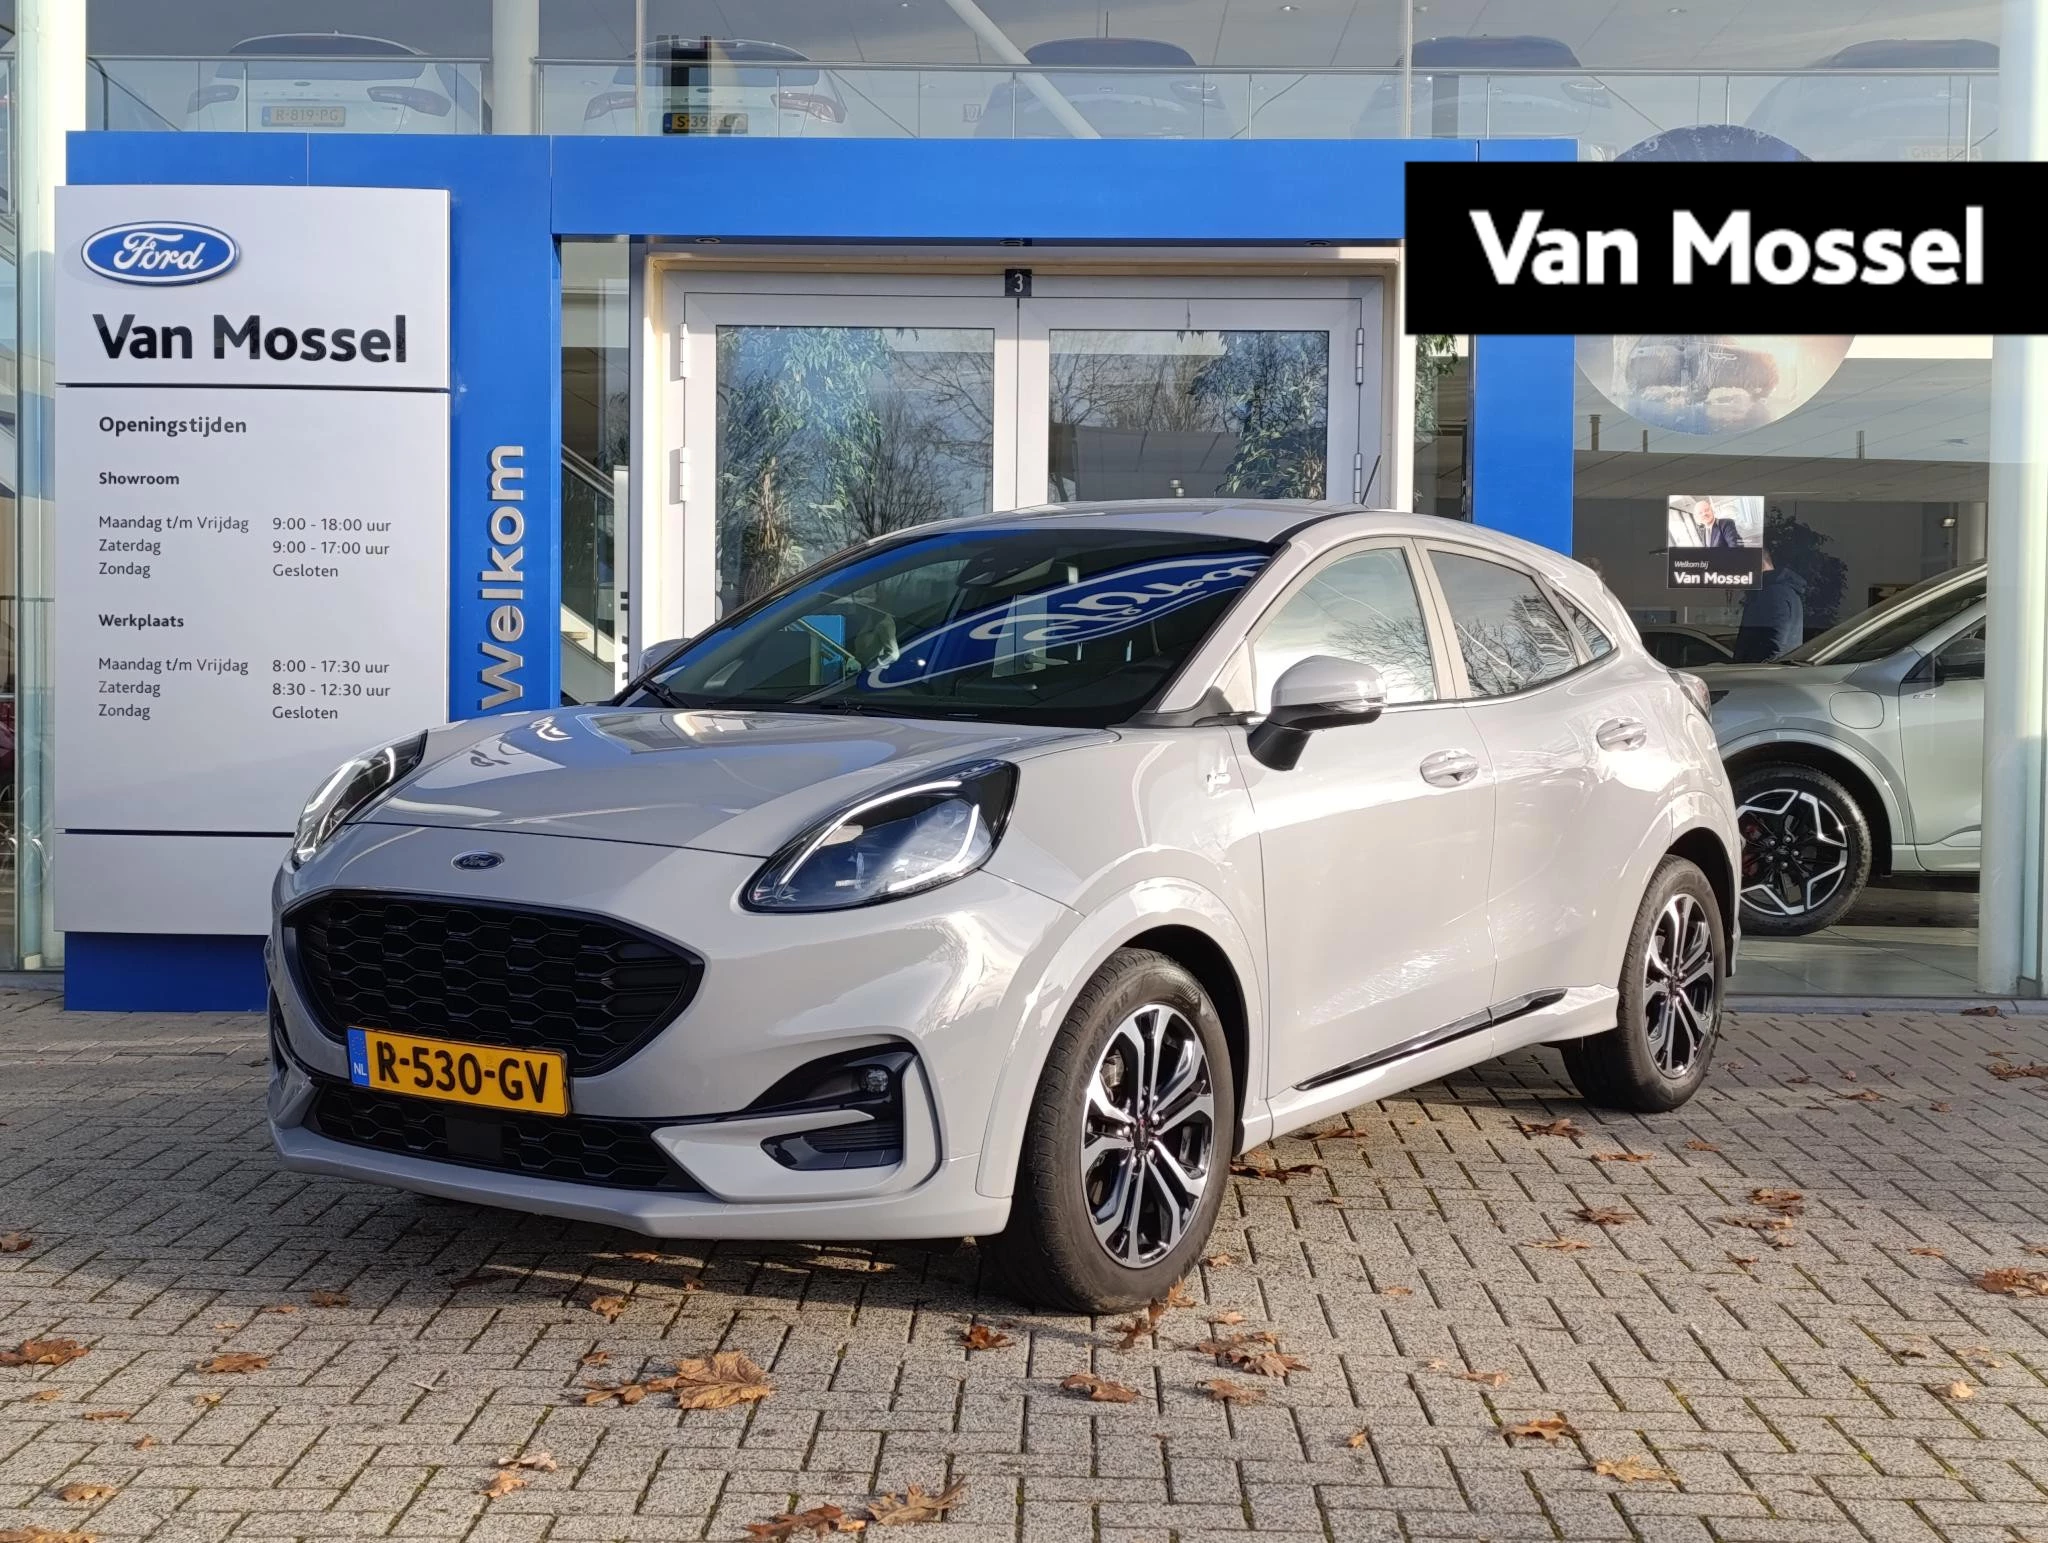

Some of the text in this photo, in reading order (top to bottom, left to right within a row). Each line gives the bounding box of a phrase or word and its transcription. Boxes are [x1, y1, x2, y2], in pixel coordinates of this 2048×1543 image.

[275, 108, 339, 121] R-819-PG
[113, 231, 207, 270] Ford
[1014, 273, 1024, 293] 3
[92, 313, 407, 363] Van Mossel
[99, 415, 247, 437] Openingstijden
[99, 471, 180, 485] Showroom
[99, 515, 163, 533] Maandag
[166, 515, 193, 529] t/m
[196, 516, 249, 534] Vrijdag
[272, 517, 306, 531] 9:00
[320, 518, 363, 532] 18:00
[366, 522, 392, 532] uur
[99, 538, 162, 556] Zaterdag
[272, 540, 306, 554] 9:00
[320, 541, 361, 555] 17:00
[365, 545, 390, 555] uur
[98, 561, 339, 579] Zondag Gesloten
[481, 445, 525, 711] Welkom
[1673, 572, 1753, 585] Van Mossel
[98, 613, 184, 631] Werkplaats
[98, 657, 162, 675] Maandag
[165, 657, 192, 672] t/m
[196, 658, 249, 676] Vrijdag
[272, 659, 306, 673] 8:00
[320, 660, 361, 674] 17:30
[365, 664, 390, 674] uur
[98, 680, 161, 698] Zaterdag
[272, 682, 306, 696] 8:30
[320, 683, 362, 697] 12:30
[366, 687, 391, 697] uur
[98, 703, 338, 721] Zondag Gesloten
[353, 1041, 548, 1103] NL R-530-GV
